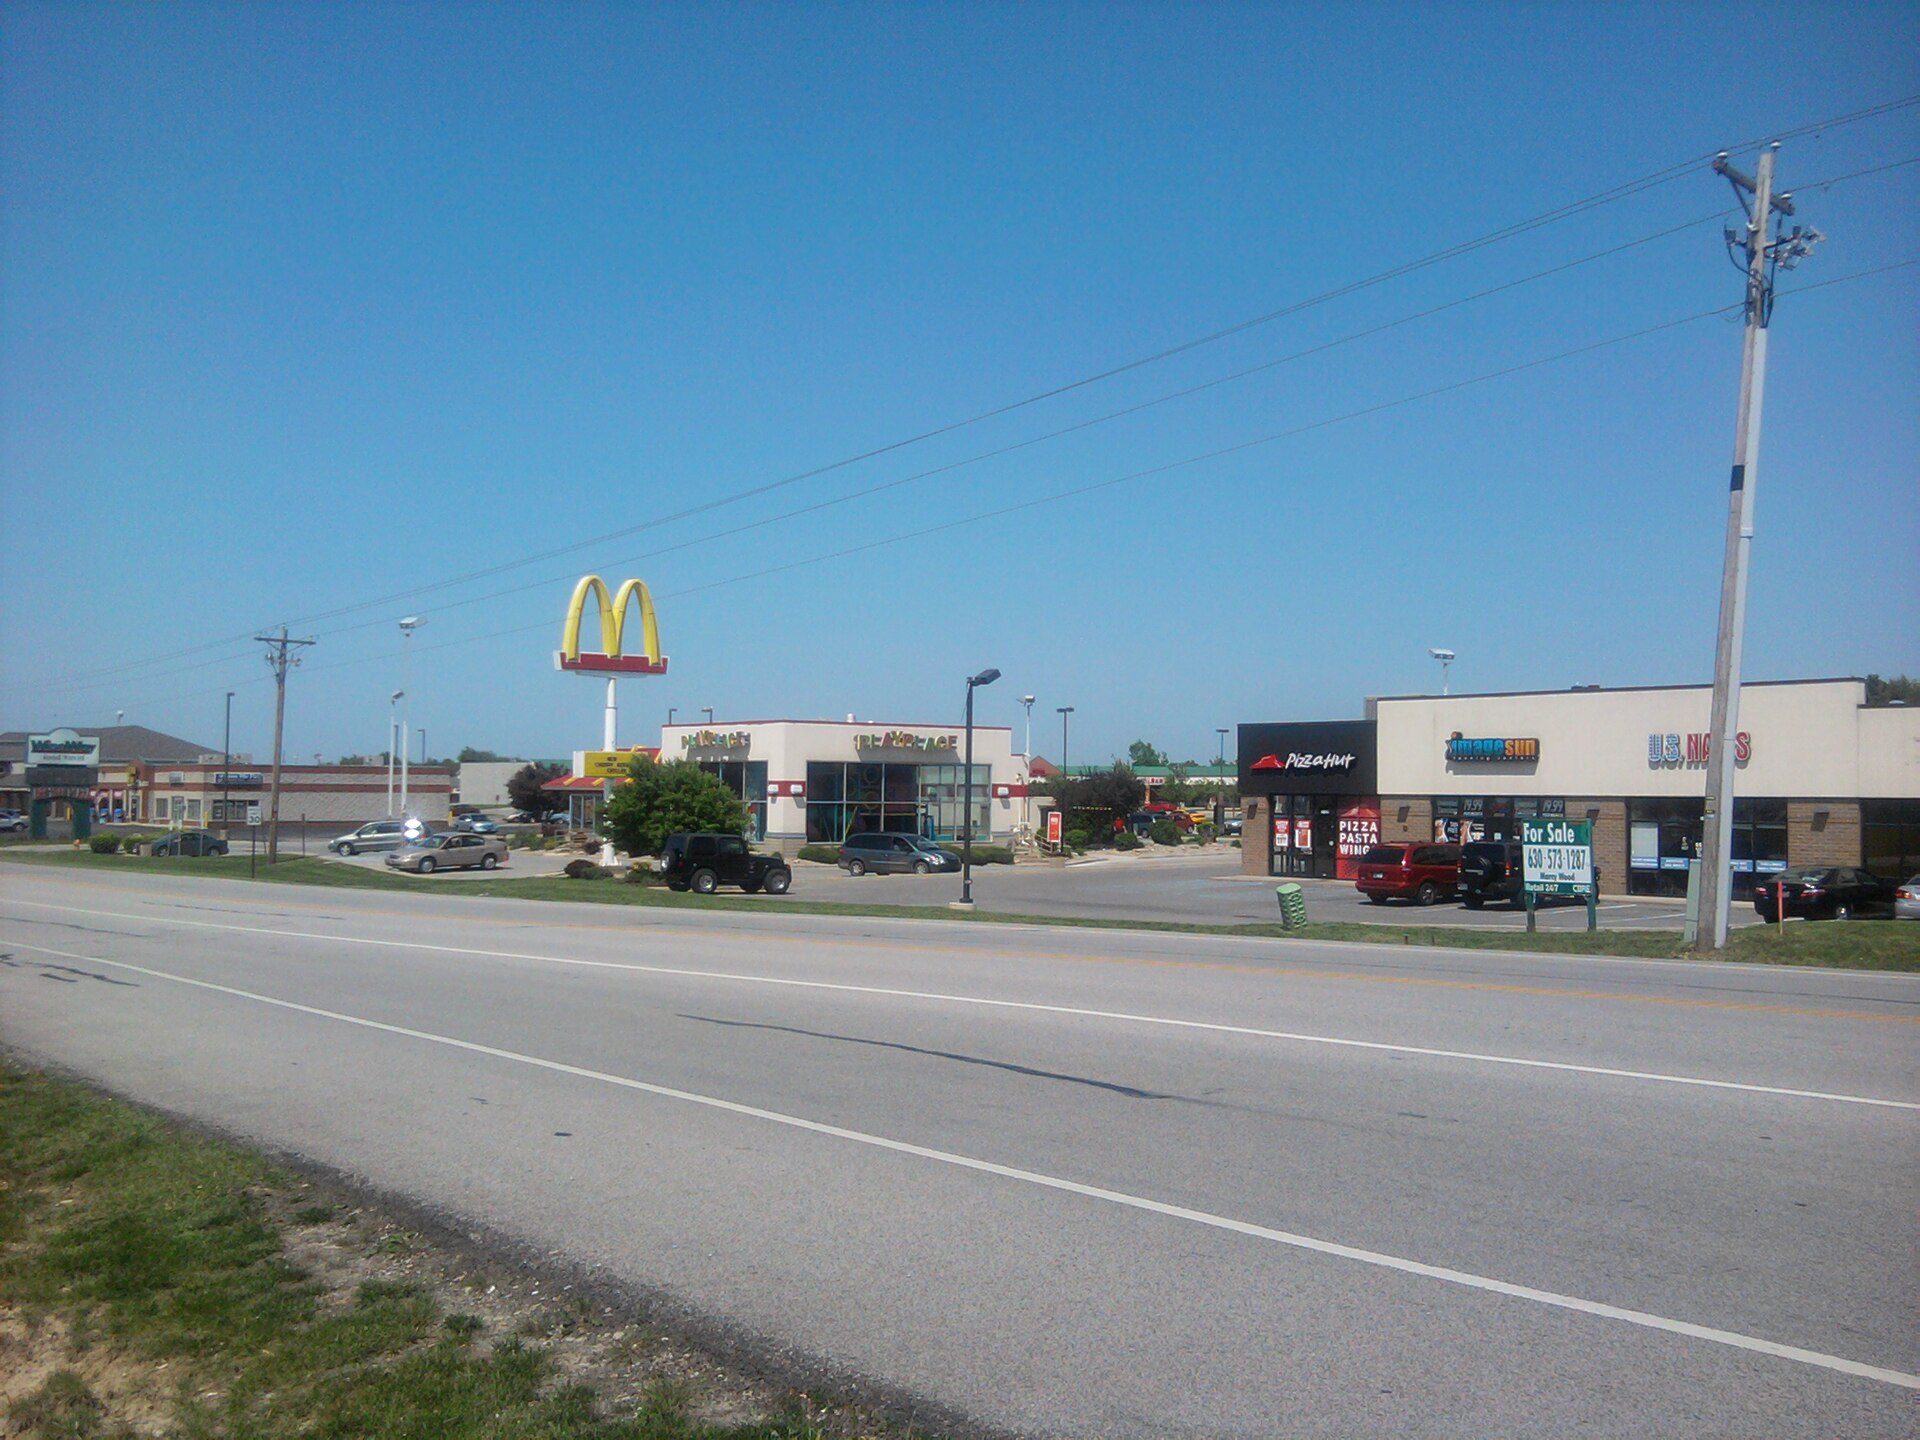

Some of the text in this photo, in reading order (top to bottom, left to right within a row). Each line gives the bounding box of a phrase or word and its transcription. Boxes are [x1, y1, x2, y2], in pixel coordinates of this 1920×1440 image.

[853, 730, 958, 751] PLAYPLACE
[1648, 731, 1750, 761] U.S. NAS
[248, 815, 260, 823] 30
[1339, 821, 1378, 832] PIZZA
[1523, 822, 1575, 843] For Sale
[1339, 833, 1378, 844] PASTA
[1339, 845, 1371, 855] WING
